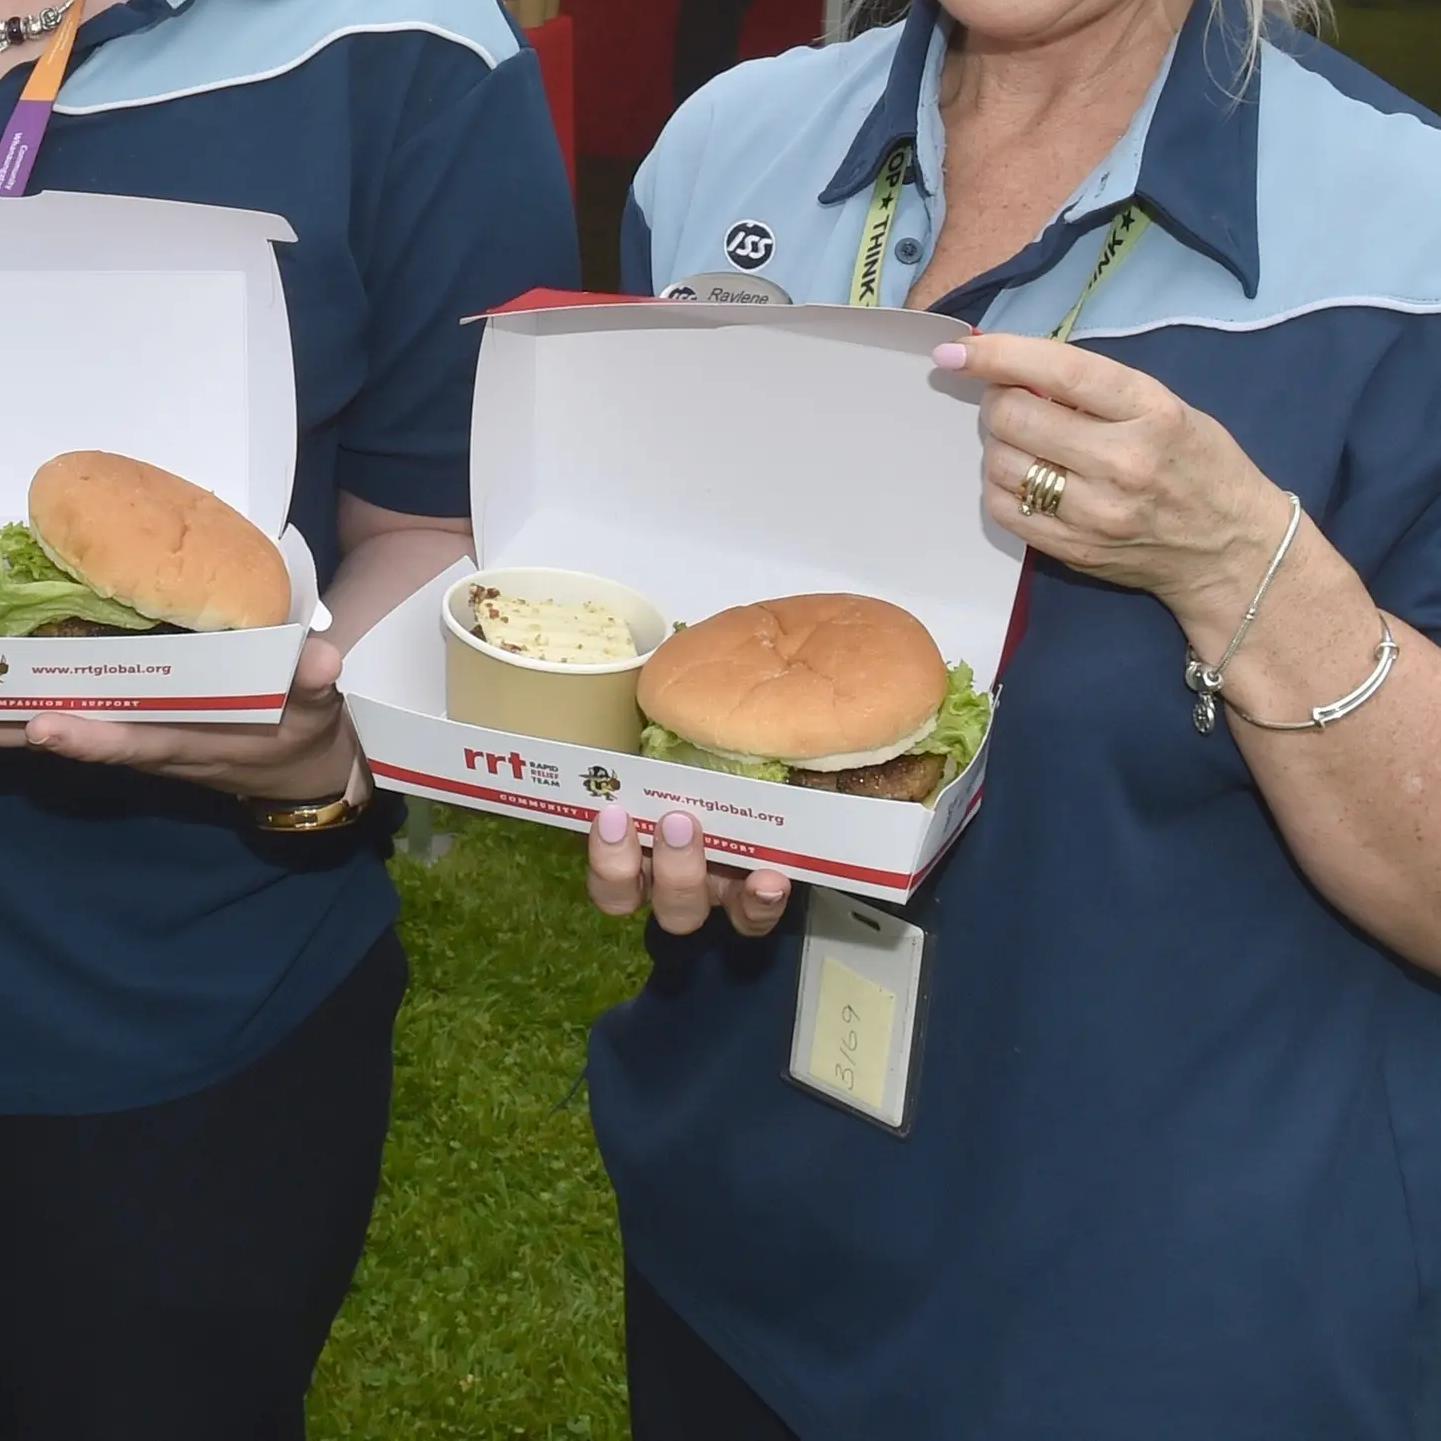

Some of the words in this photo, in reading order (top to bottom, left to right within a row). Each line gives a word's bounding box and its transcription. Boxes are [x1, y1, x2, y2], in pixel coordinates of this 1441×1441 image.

[886, 150, 905, 188] OP
[859, 213, 890, 302] THINK
[31, 663, 172, 677] www.rrtglobal.org
[81, 700, 141, 708] SUPPORT
[463, 747, 527, 780] rrt
[529, 761, 559, 773] RAPID
[530, 769, 560, 780] RELIEF
[531, 776, 561, 788] TEAM
[643, 787, 785, 827] www.rrtglobal.org
[499, 793, 579, 816] COMMUNITY
[704, 837, 757, 854] UPPORT
